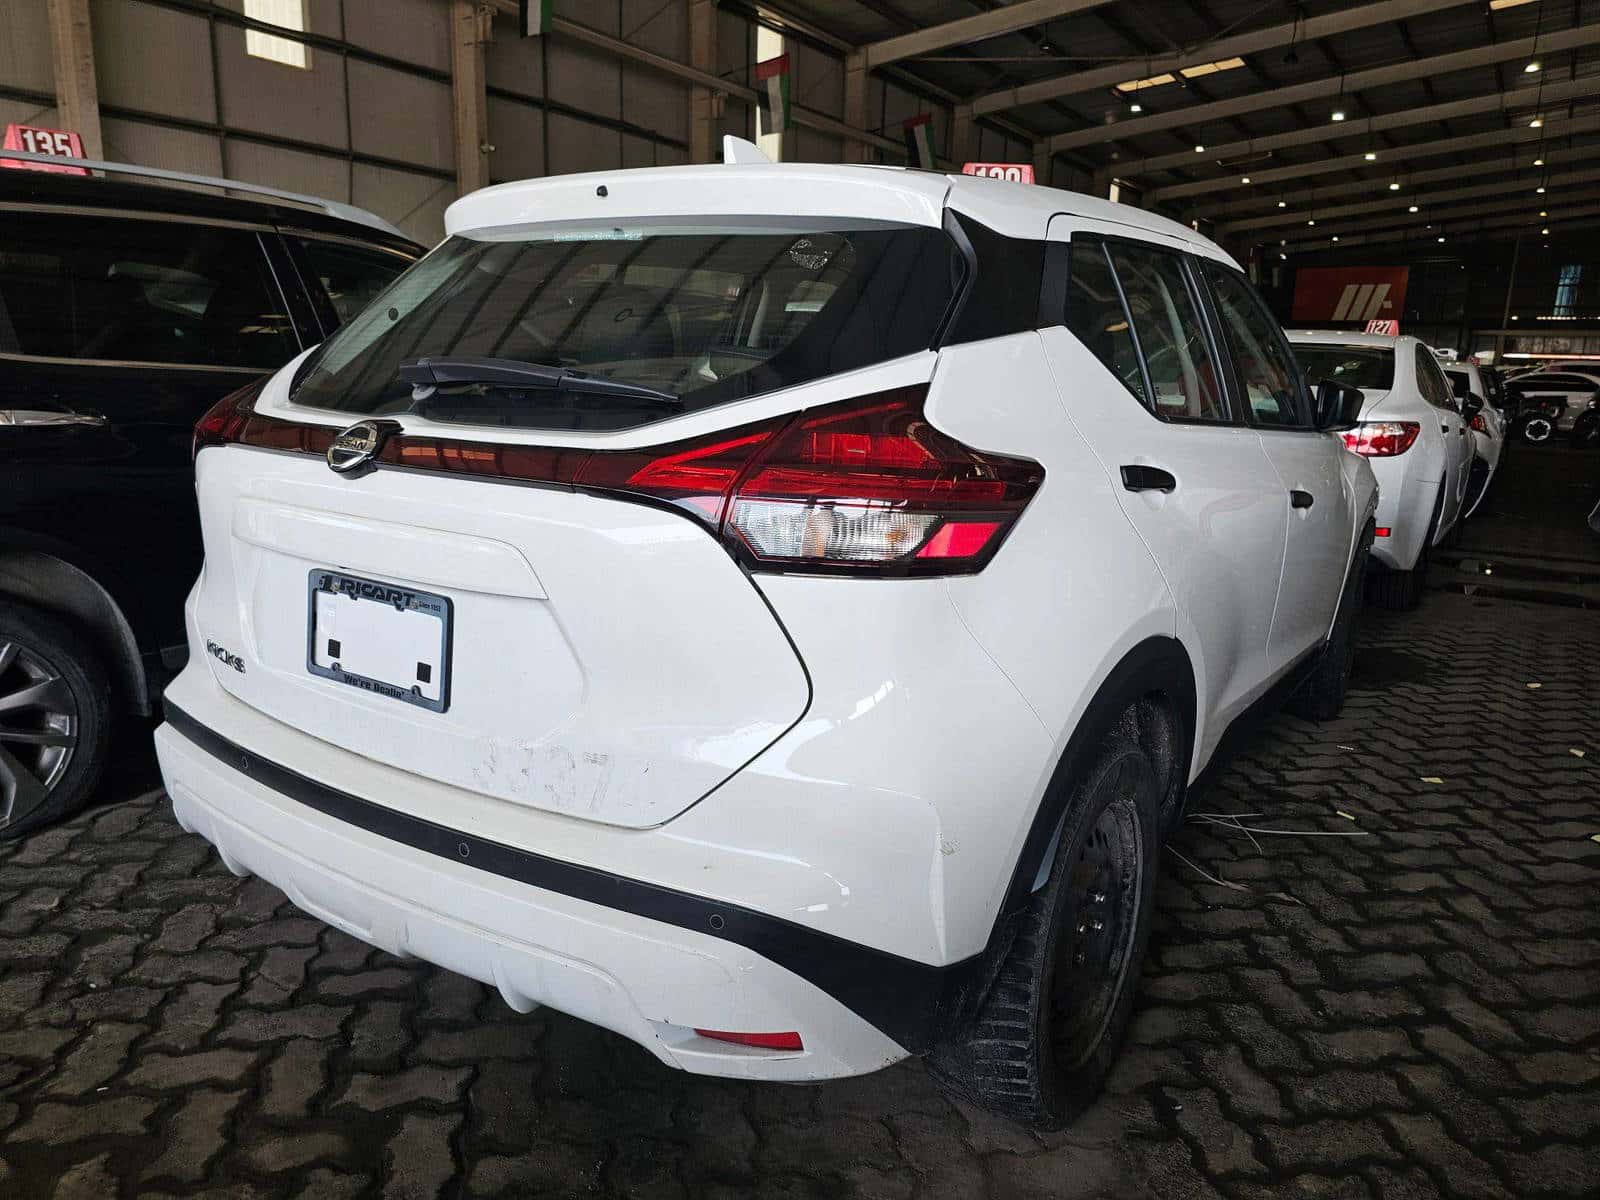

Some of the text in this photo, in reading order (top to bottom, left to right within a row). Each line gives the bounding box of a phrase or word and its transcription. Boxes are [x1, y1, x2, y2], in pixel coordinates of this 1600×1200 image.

[23, 129, 73, 157] 135
[1370, 320, 1391, 336] 127
[340, 577, 416, 612] RICART
[343, 673, 371, 690] We're
